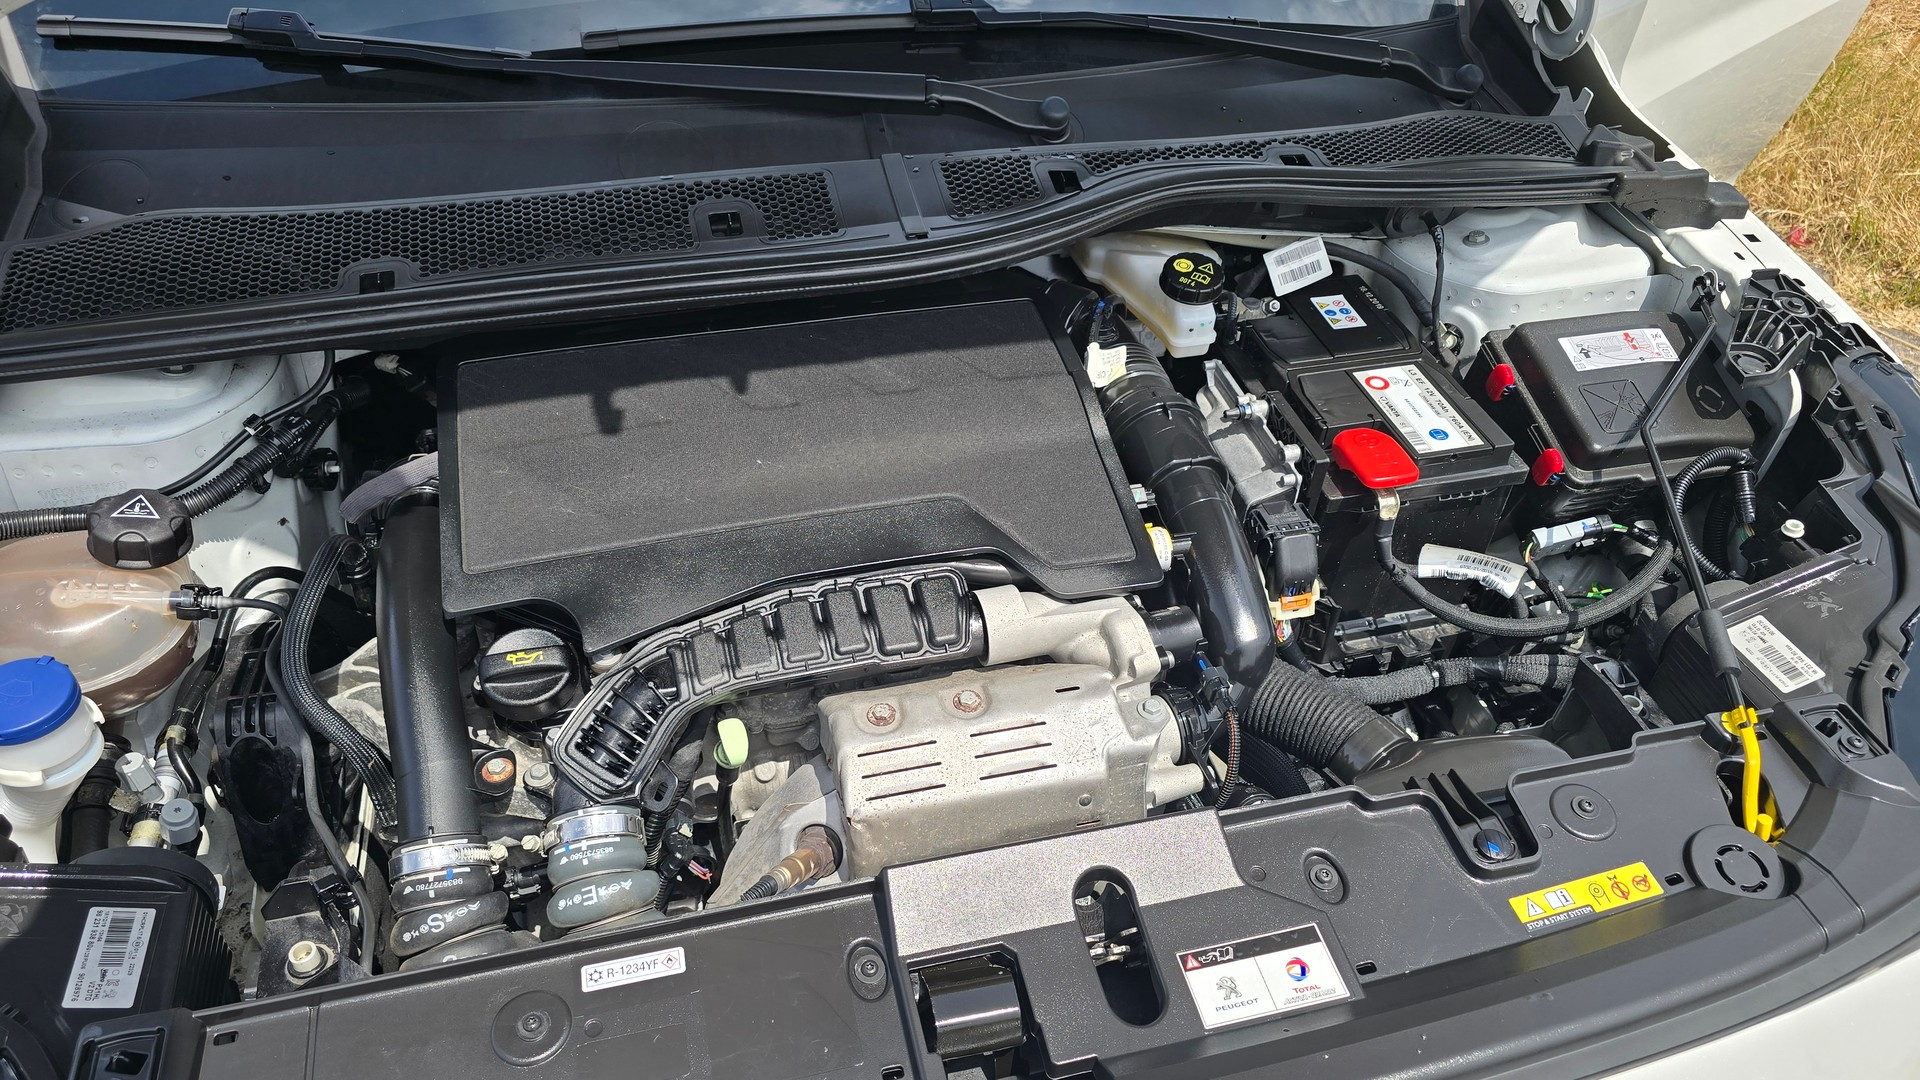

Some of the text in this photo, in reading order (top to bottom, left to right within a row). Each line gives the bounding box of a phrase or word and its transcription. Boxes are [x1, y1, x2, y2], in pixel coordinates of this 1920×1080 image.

[1179, 277, 1191, 285] DOT
[1408, 368, 1415, 376] L3
[1424, 388, 1436, 397] 12V
[1434, 399, 1449, 412] 70Ah
[1448, 415, 1464, 429] 760A
[1385, 402, 1401, 417] VARTA
[570, 846, 613, 861] 9835737580
[416, 878, 464, 891] 9835727780
[93, 918, 101, 927] 231
[1527, 920, 1544, 930] STOP
[1550, 912, 1569, 924] START
[1570, 906, 1593, 918] SYSTEM
[89, 930, 97, 939] 938
[607, 959, 659, 978] R-1234YF
[71, 973, 85, 1001] 90128976
[1292, 985, 1321, 994] TOTAL
[1215, 997, 1259, 1012] PEUGEOT
